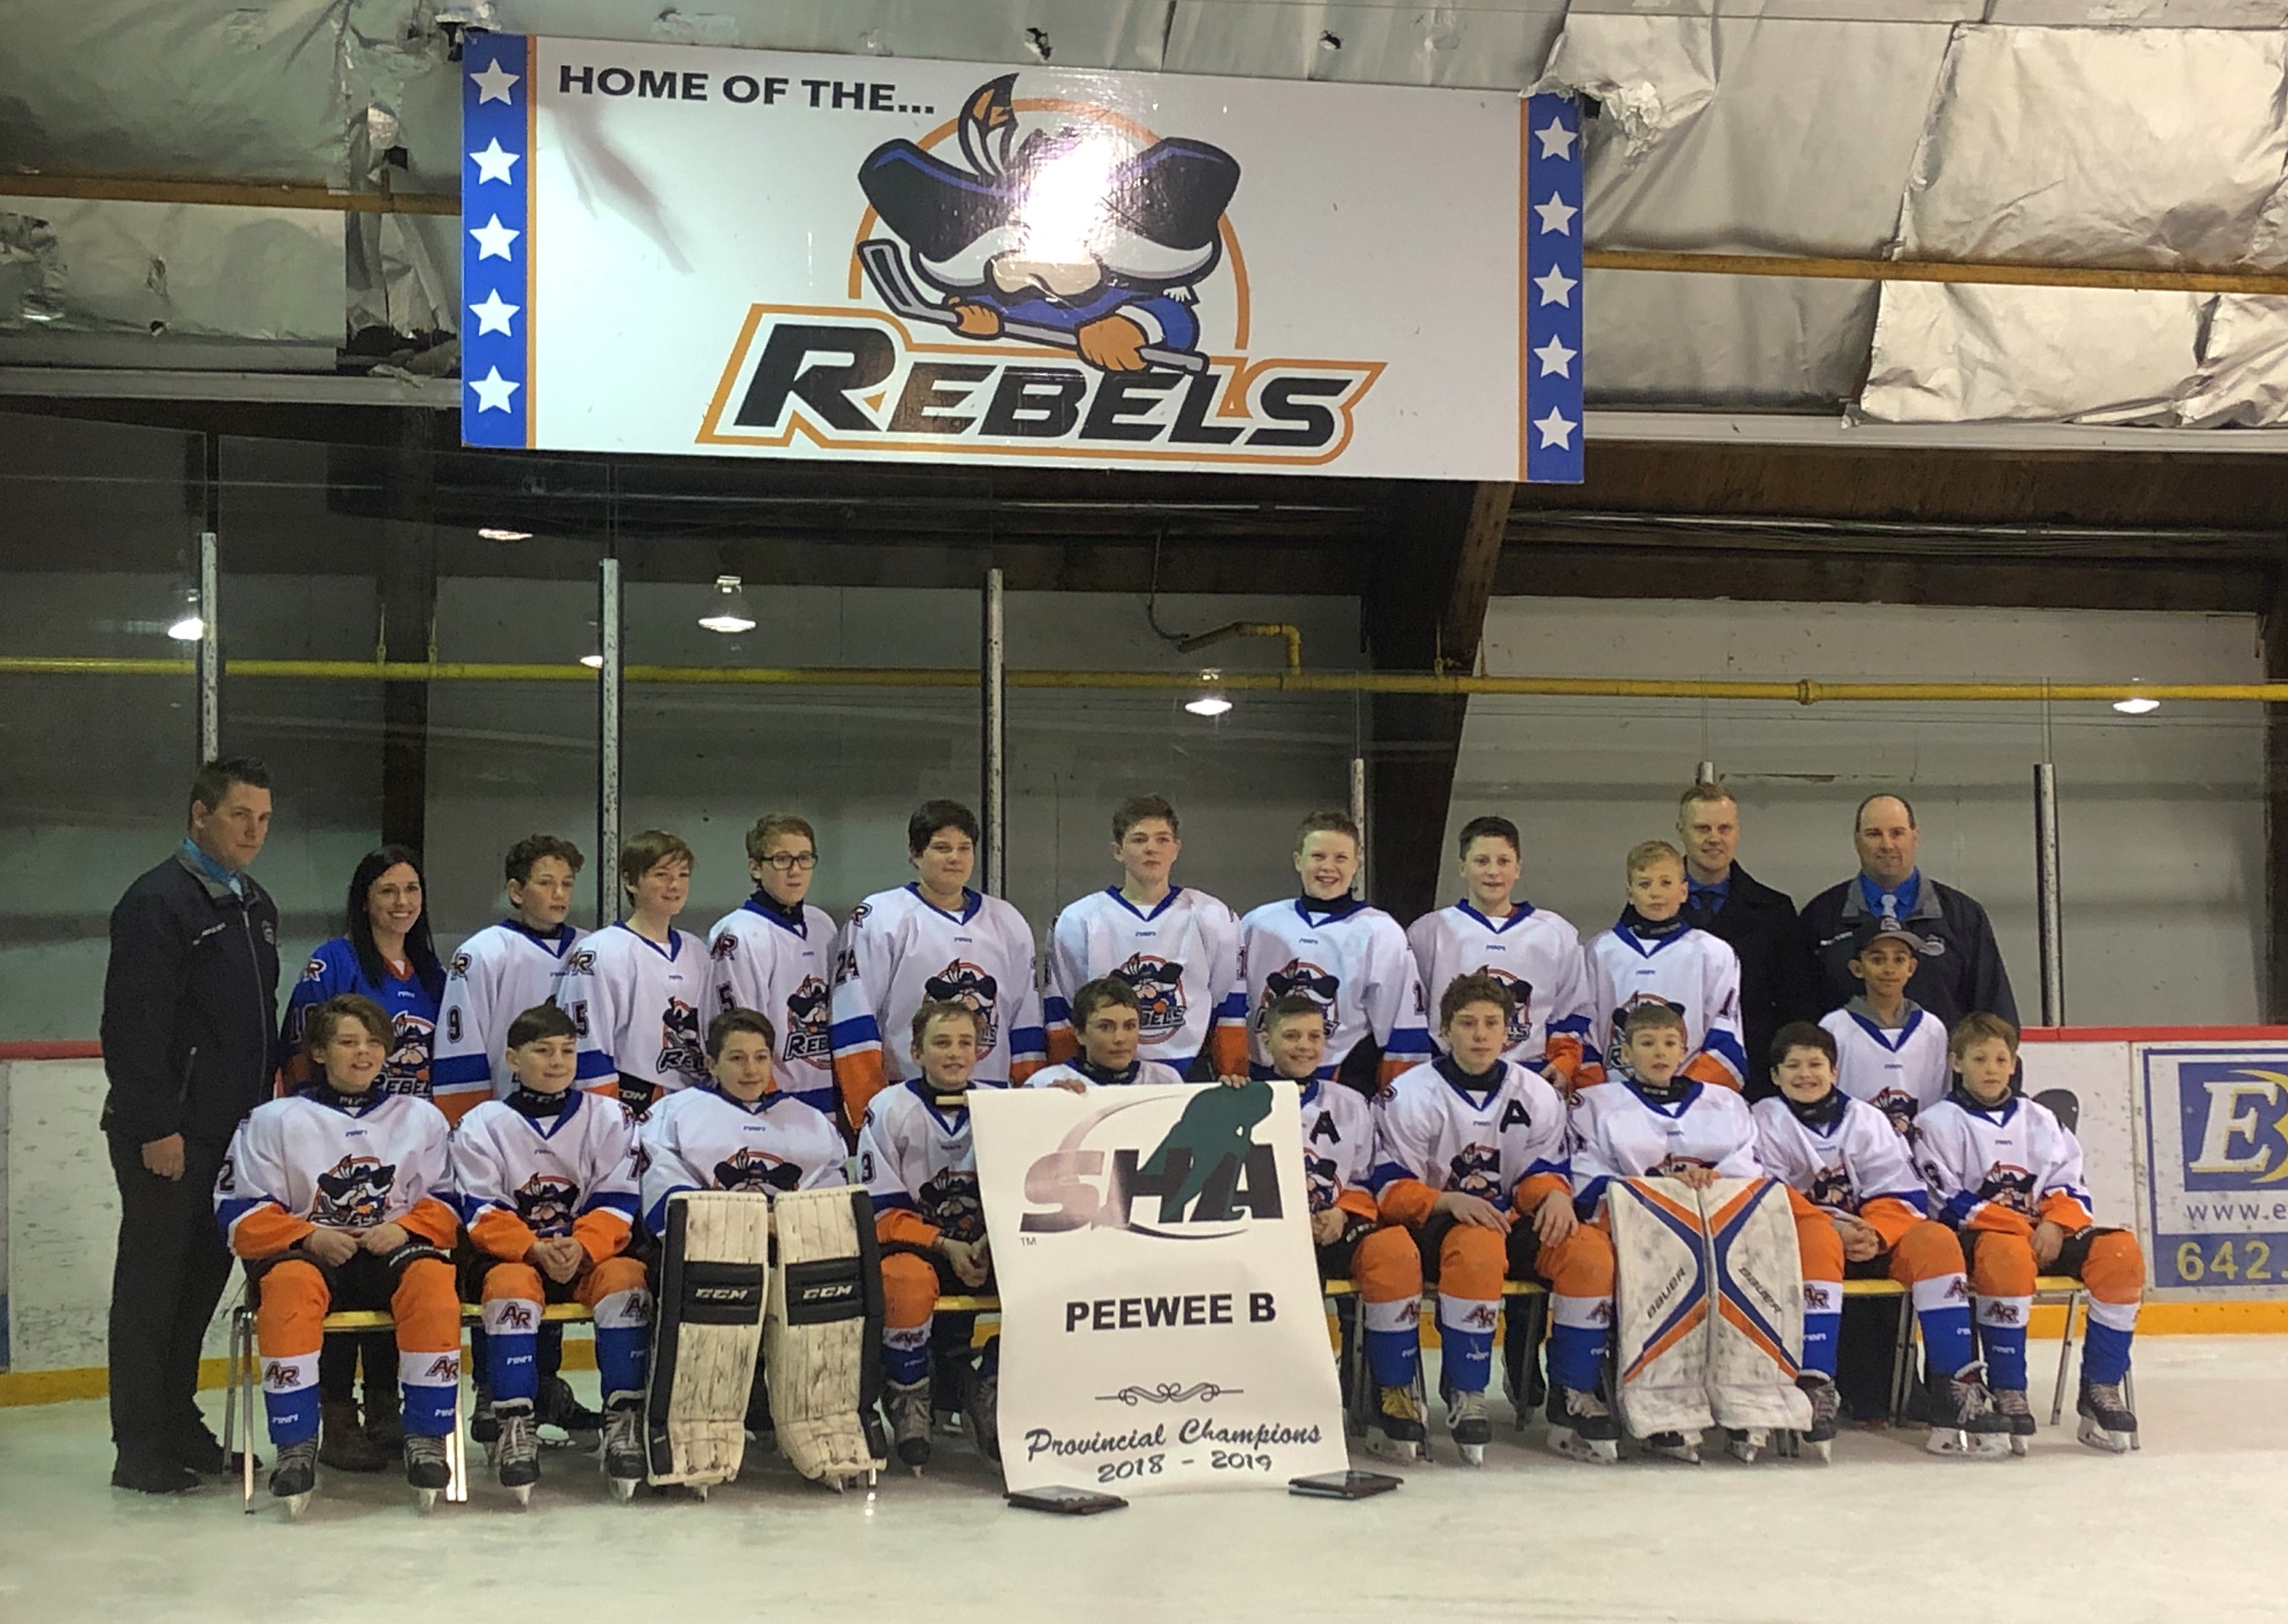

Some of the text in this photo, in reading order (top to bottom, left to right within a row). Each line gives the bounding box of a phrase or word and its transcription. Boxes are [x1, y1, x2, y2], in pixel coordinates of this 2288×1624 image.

[559, 64, 935, 114] HOME OF THE...
[732, 322, 1354, 448] REBELS
[835, 948, 860, 988] 24
[447, 1005, 464, 1044] 9
[1309, 1110, 1342, 1144] A
[1499, 1099, 1531, 1134] A
[1018, 1144, 1284, 1234] SHA
[1020, 1237, 1037, 1246] TM
[695, 1287, 748, 1300] CCM
[802, 1284, 853, 1300] CCM
[1646, 1266, 1687, 1320] BAUER
[1738, 1266, 1783, 1315] BAUER
[1065, 1292, 1277, 1333] PEEWEE B
[1023, 1417, 1322, 1462] Provincial Champions
[1097, 1454, 1166, 1483] 2018
[1210, 1450, 1272, 1472] 2019
